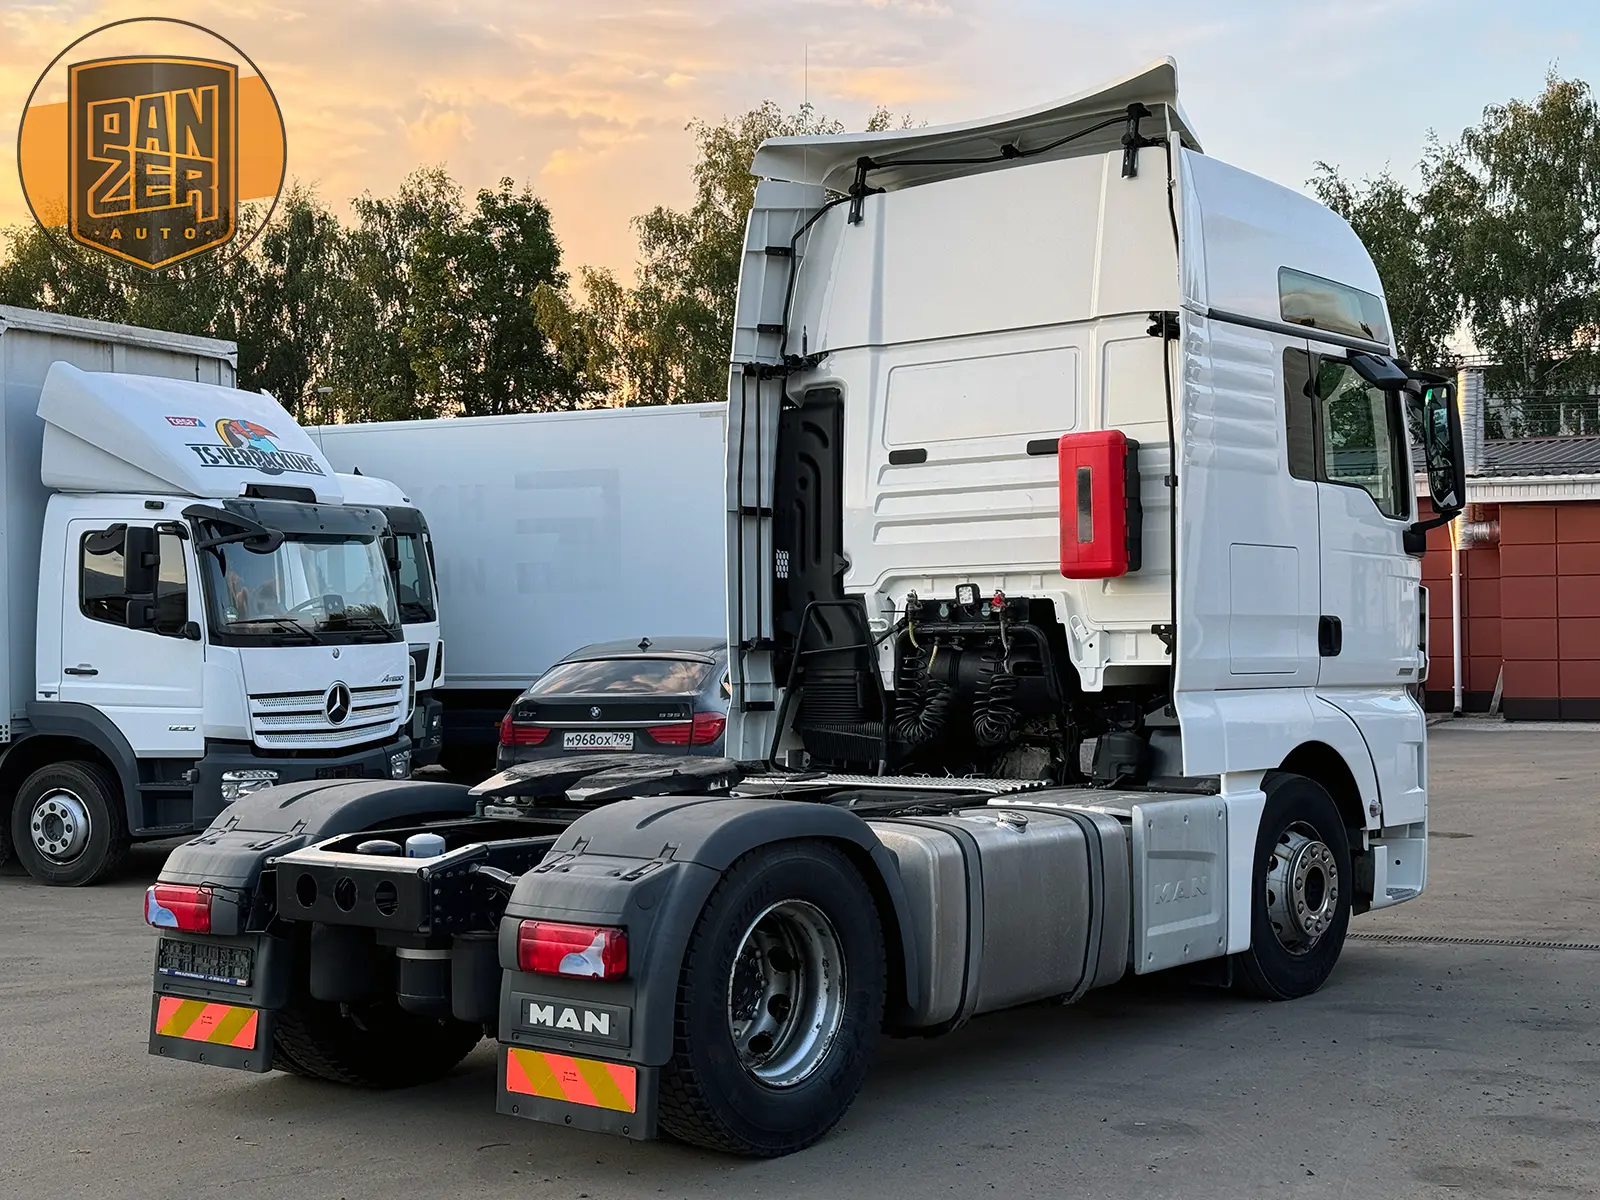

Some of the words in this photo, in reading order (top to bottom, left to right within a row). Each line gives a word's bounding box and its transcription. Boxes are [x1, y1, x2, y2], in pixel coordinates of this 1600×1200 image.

[169, 417, 198, 427] tesa
[192, 446, 323, 474] TS-VERPACKUNG
[613, 733, 631, 742] 799
[1154, 876, 1207, 905] MAN
[529, 1003, 610, 1035] MAN
